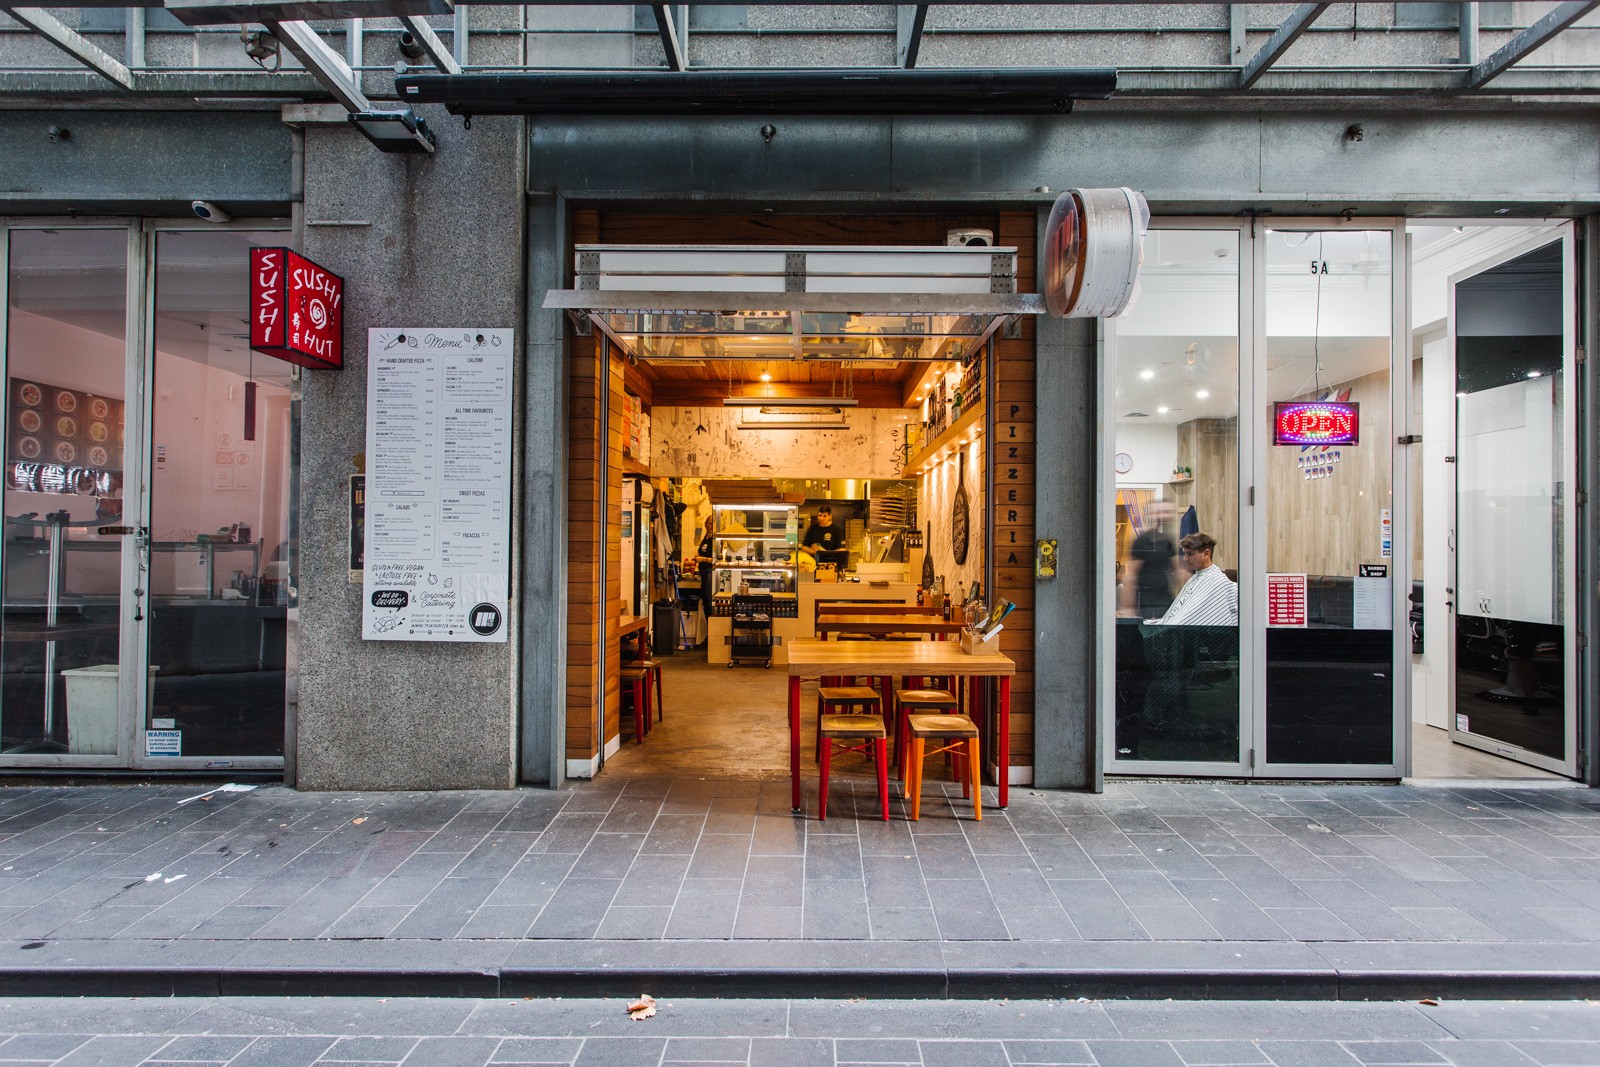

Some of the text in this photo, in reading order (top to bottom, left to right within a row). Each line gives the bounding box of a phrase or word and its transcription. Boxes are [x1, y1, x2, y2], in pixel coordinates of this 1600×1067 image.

[293, 268, 341, 309] SUSHI
[259, 253, 279, 343] SUSHI
[304, 329, 334, 357] HUT
[424, 334, 463, 348] Menu
[1281, 412, 1353, 434] OPEN
[1298, 451, 1341, 468] BARBER
[1304, 466, 1334, 480] SHOP
[1007, 405, 1020, 564] PIZZERIA
[371, 564, 391, 572] GLUTEN
[405, 564, 425, 572] VEGAN
[378, 571, 403, 579] LACTOSE
[402, 572, 418, 580] FREE
[419, 590, 457, 601] Corporate
[421, 599, 456, 609] Catering
